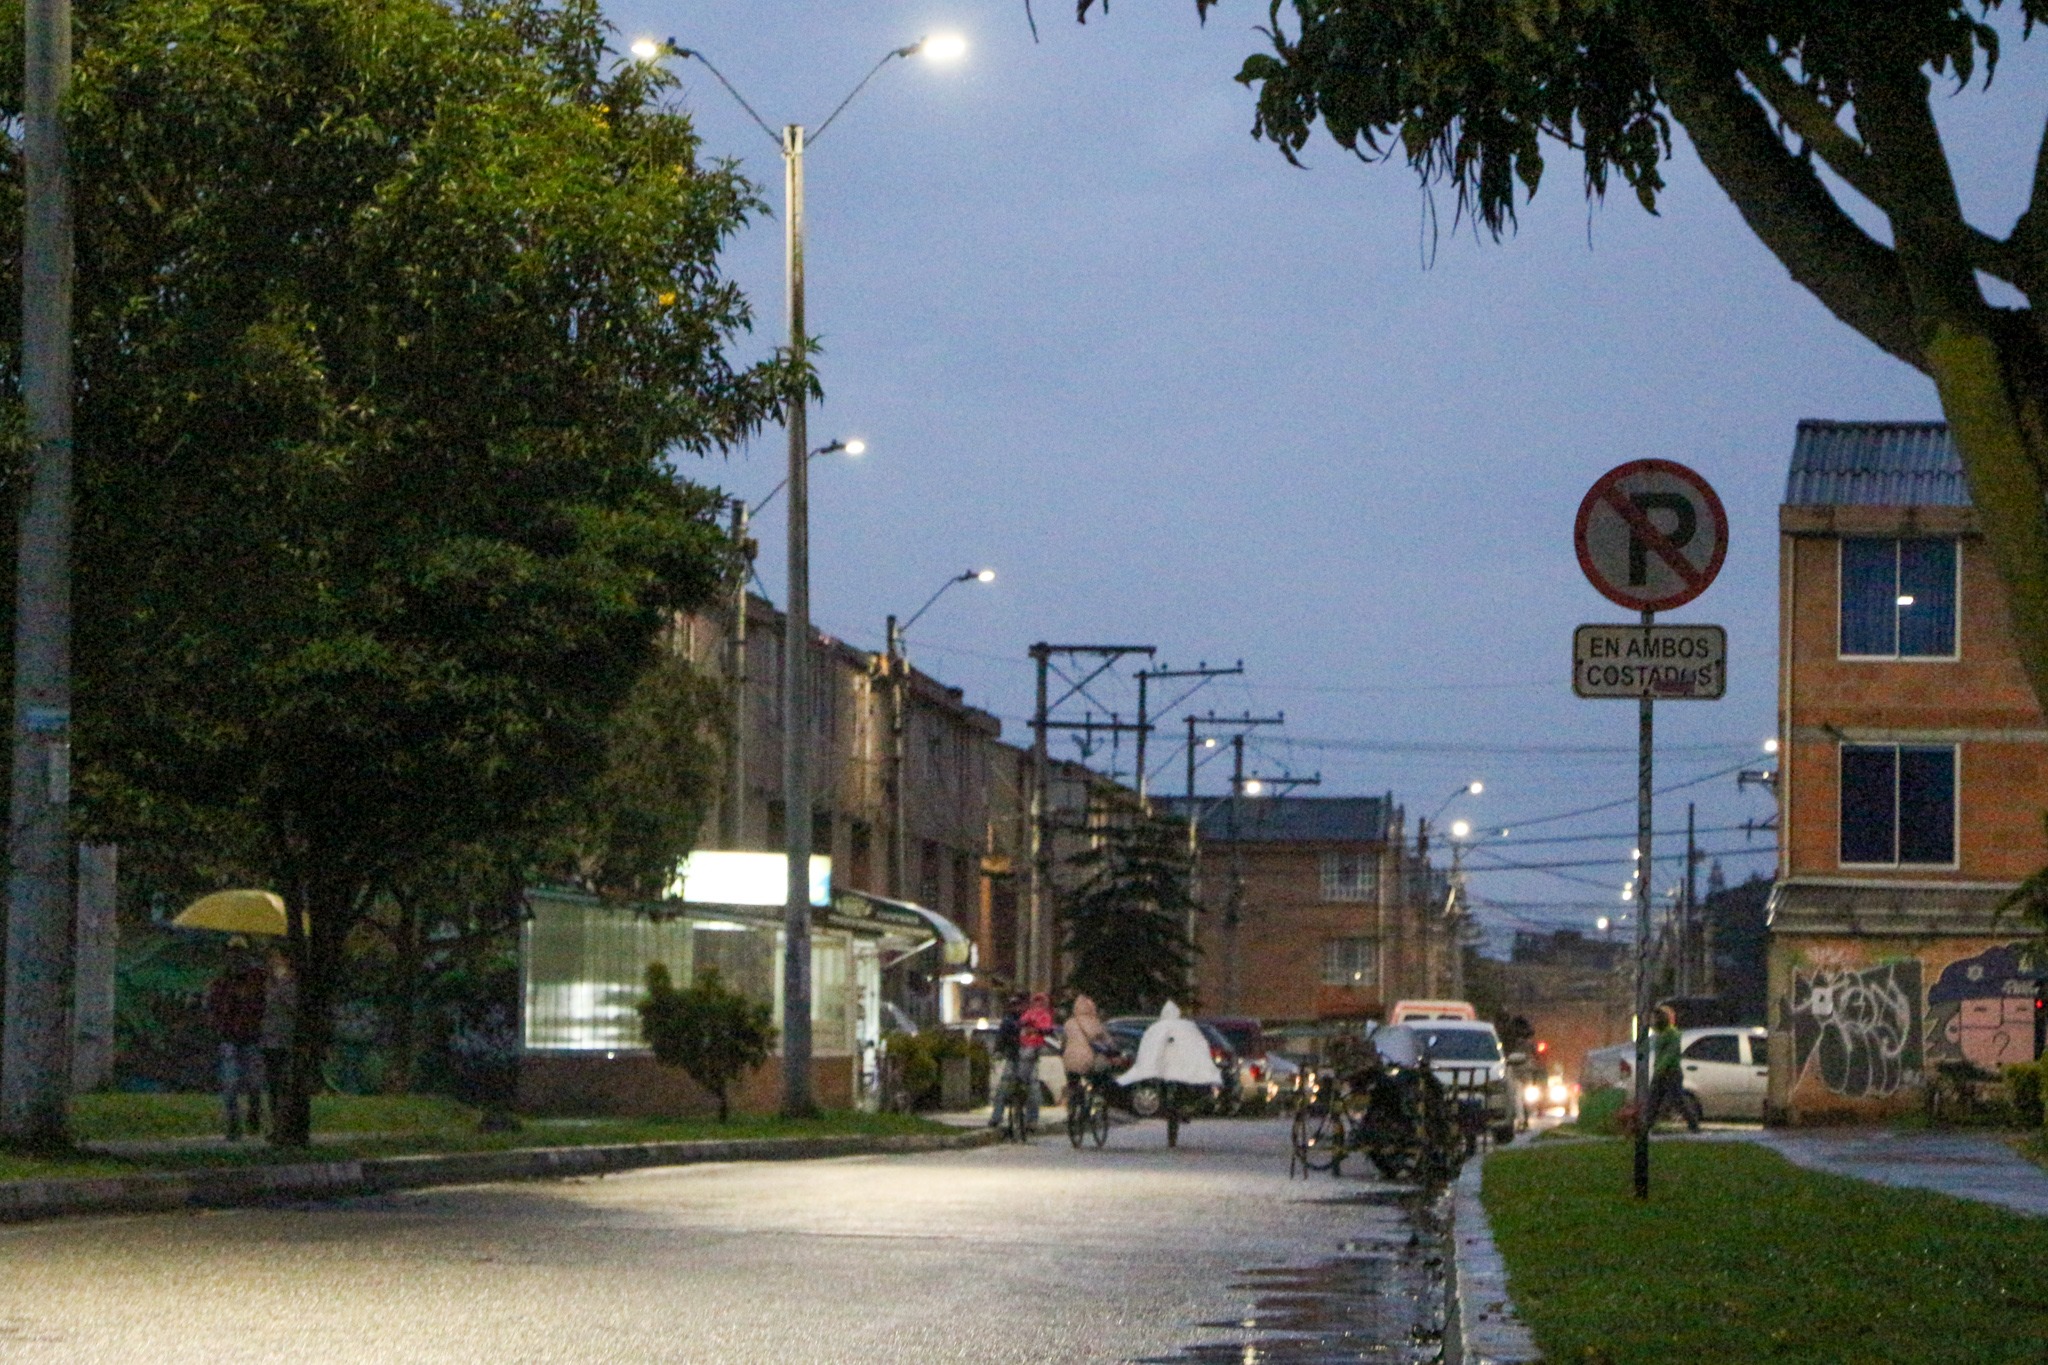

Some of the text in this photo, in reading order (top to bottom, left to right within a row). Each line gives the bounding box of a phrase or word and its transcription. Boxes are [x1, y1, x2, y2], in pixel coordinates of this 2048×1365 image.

[1628, 492, 1696, 587] P
[1590, 637, 1709, 659] EN AMBOS
